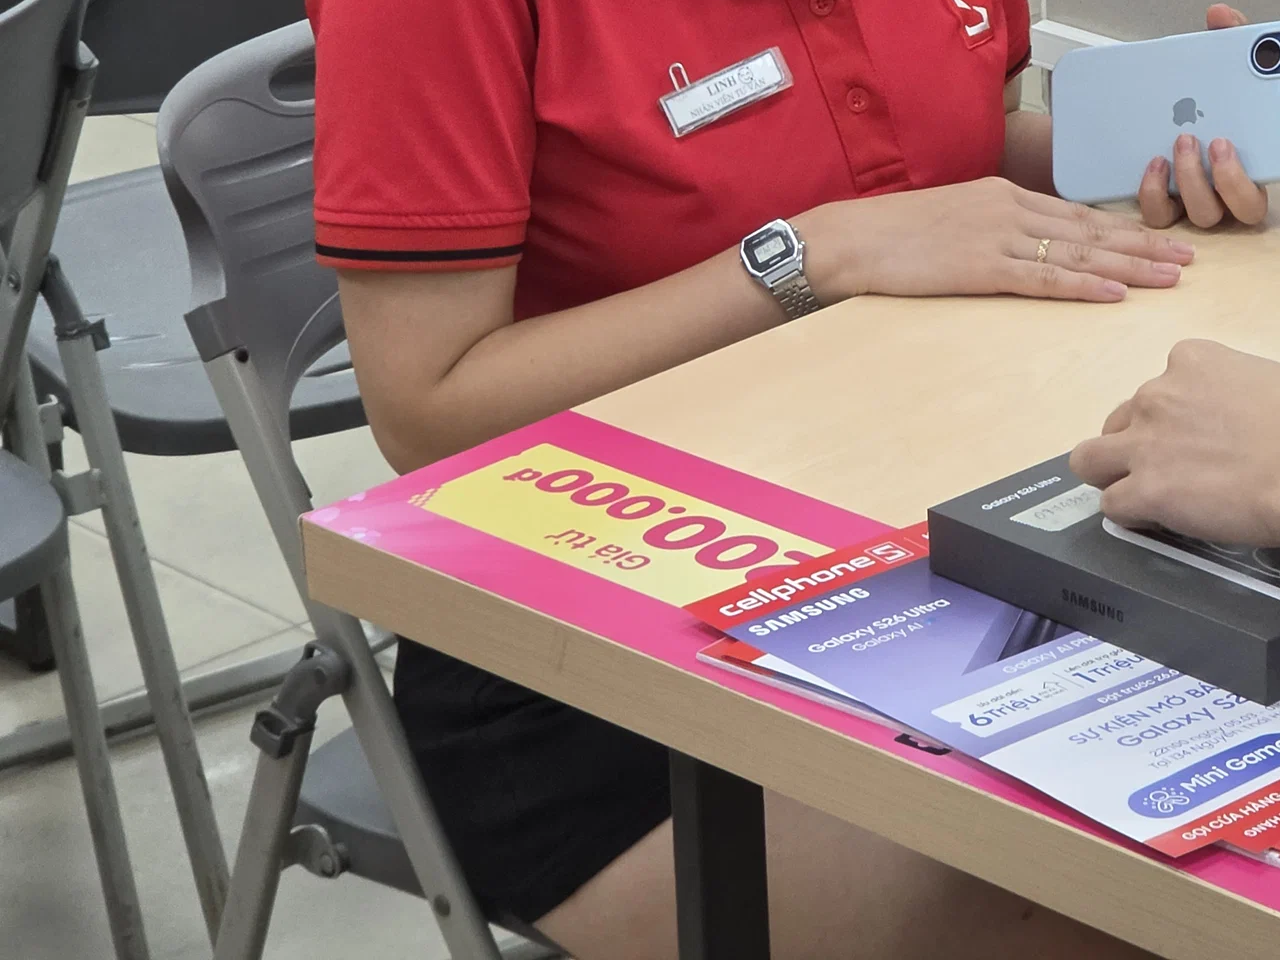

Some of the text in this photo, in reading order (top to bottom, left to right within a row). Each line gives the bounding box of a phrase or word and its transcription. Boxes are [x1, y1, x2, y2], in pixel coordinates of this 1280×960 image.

[706, 74, 738, 97] LINH
[981, 493, 1021, 511] Galaxy
[1017, 486, 1037, 497] S26
[1034, 476, 1062, 489] Ultra
[595, 544, 651, 571] Giá
[748, 587, 871, 637] SAMSUNG
[1062, 588, 1124, 623] SAMSUNG
[808, 598, 951, 654] Galaxy S26 Ultra
[852, 630, 907, 652] Galaxy
[1002, 651, 1057, 674] Galaxy
[1088, 654, 1145, 677] Triệu
[969, 695, 1042, 727] 6 Triệu
[1069, 681, 1222, 745] SỰ KIỆN MỞ BÁ
[1116, 707, 1216, 747] Galaxy
[1212, 692, 1250, 710] S2
[1179, 766, 1229, 794] Mini
[1182, 824, 1212, 842] GỌI
[1212, 807, 1247, 830] CỬA
